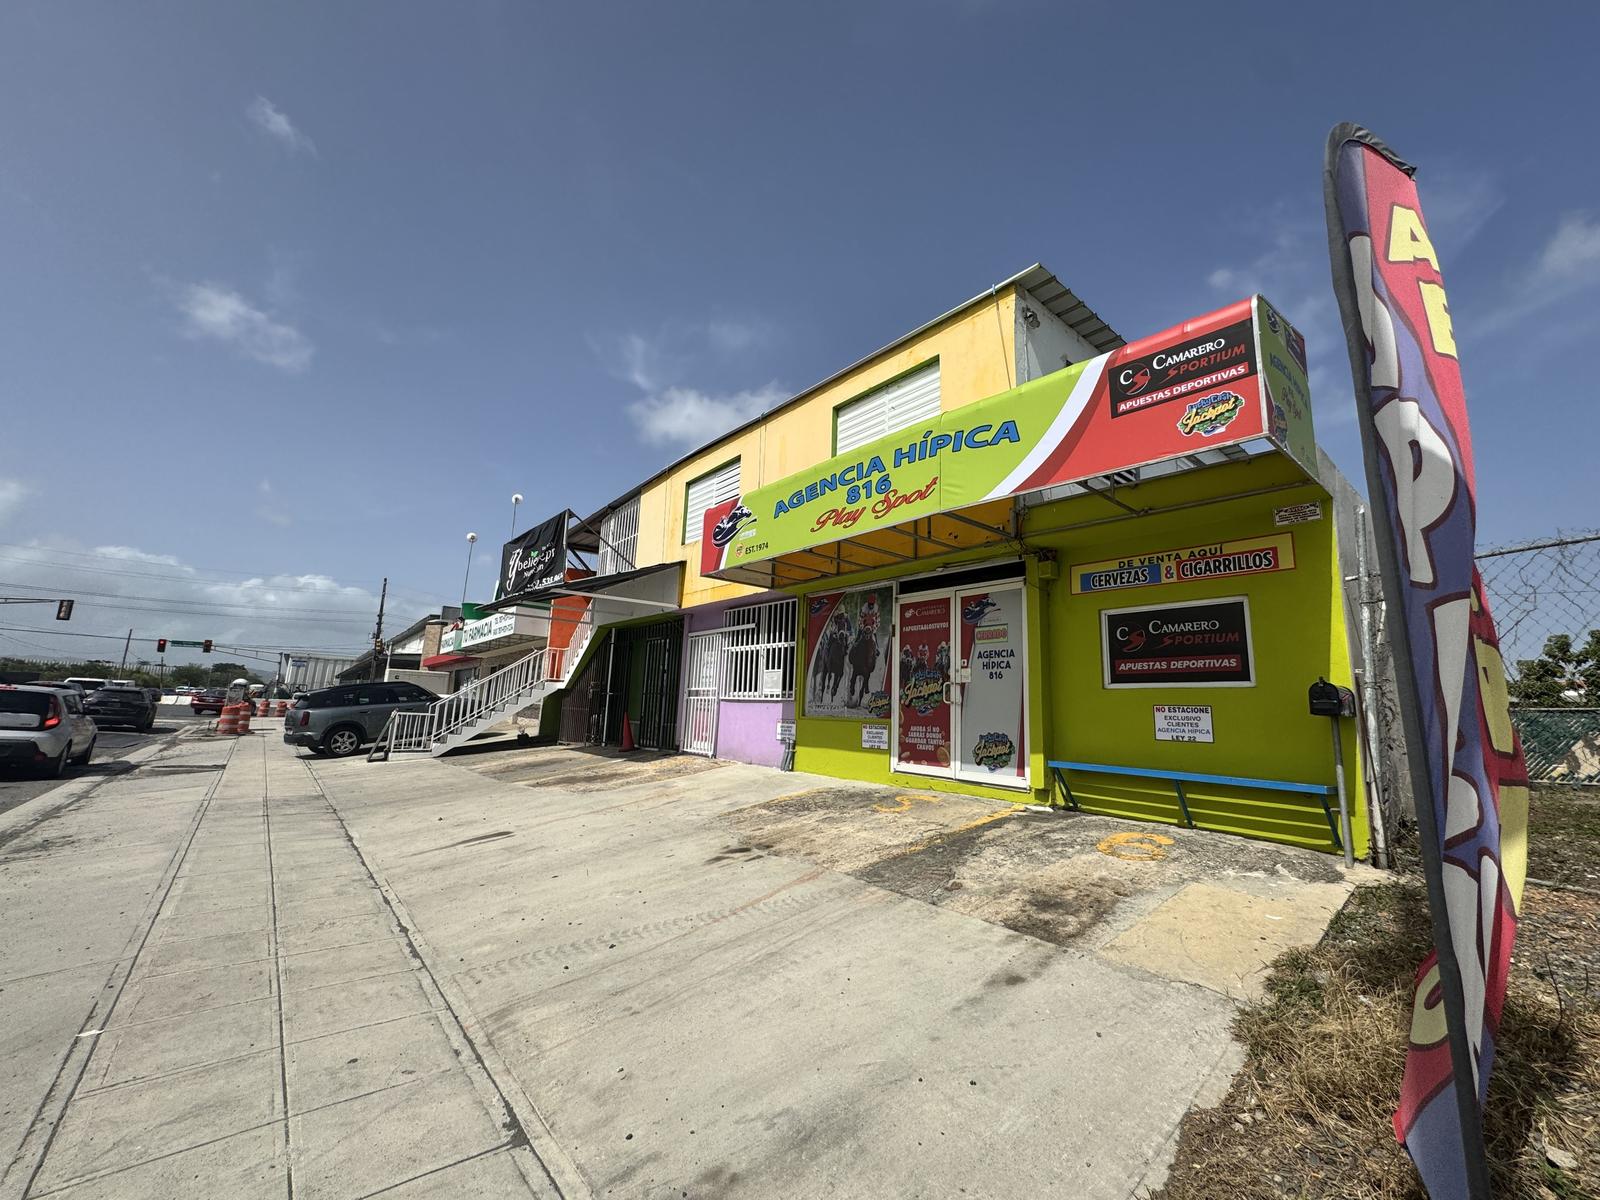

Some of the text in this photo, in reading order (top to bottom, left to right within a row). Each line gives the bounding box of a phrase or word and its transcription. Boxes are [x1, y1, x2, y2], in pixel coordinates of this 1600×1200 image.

[1152, 338, 1225, 370] CAMARERO
[1159, 344, 1246, 384] SPORTIUM
[1119, 365, 1246, 411] APUESTAS DEPORTIVAS
[1182, 396, 1235, 433] Jackpot
[774, 420, 1020, 518] AGENCIA HÍPICA
[846, 474, 892, 504] 816
[810, 476, 939, 533] Play Spot
[1118, 544, 1224, 569] DE VENTA AQUÍ
[1091, 551, 1273, 590] CERVEZAS & CIGARRILLOS
[1149, 620, 1220, 635] CAMARERO
[1156, 632, 1240, 648] SPORTIUM
[977, 649, 1015, 659] AGENCIA
[982, 659, 1011, 670] HÍPICA
[1119, 658, 1237, 671] APUESTAS DEPORTIVAS
[989, 671, 1003, 680] 816
[1168, 706, 1210, 714] ESTACIONE
